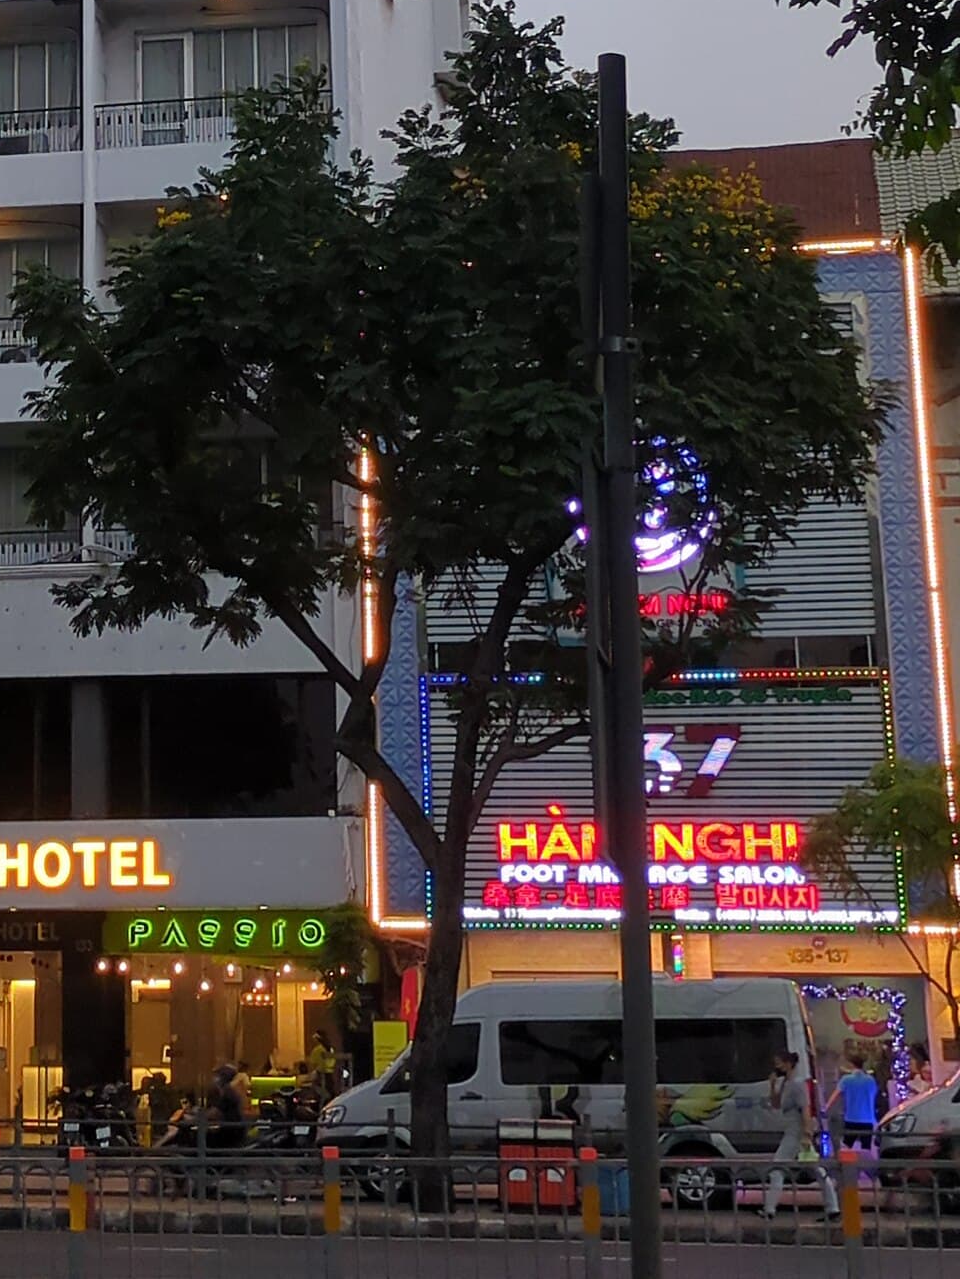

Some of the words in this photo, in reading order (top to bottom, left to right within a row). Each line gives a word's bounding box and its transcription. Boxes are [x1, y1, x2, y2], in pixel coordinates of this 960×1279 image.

[500, 864, 567, 883] FOOT
[577, 865, 708, 884] MAAGE
[716, 883, 818, 911] 발마사지
